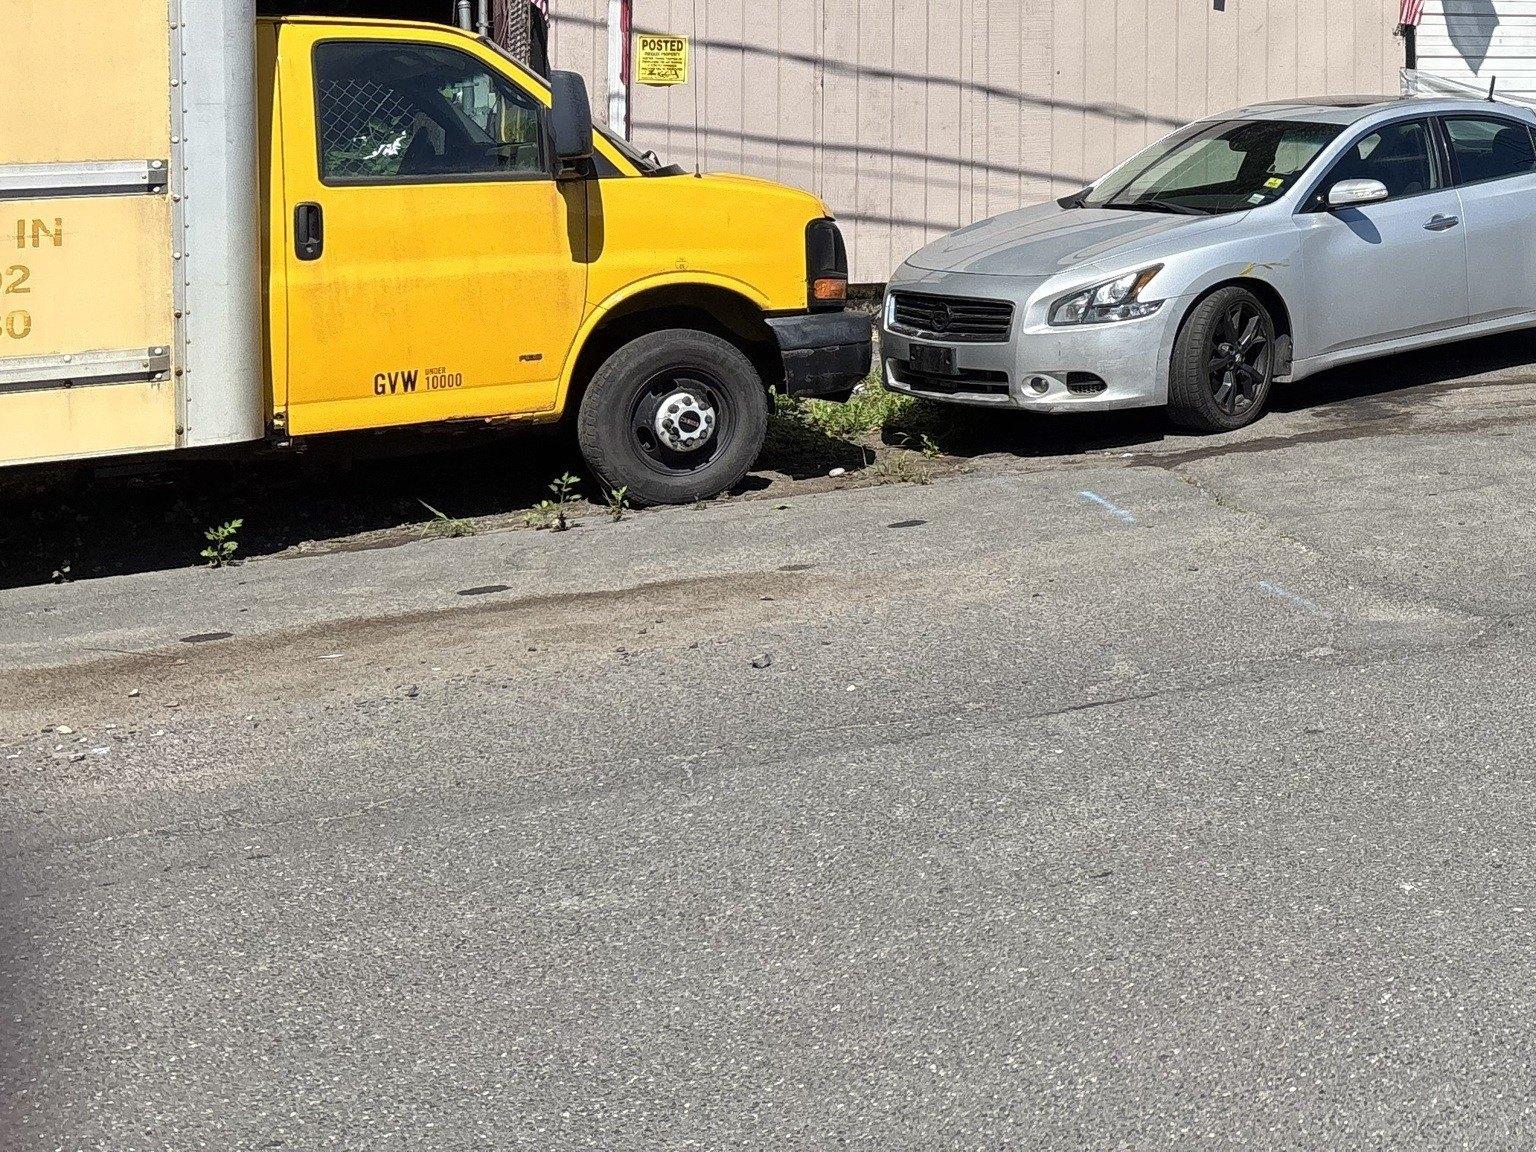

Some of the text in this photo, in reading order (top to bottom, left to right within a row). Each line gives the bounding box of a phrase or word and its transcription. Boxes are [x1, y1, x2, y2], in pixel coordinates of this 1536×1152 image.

[641, 39, 684, 51] POSTED
[17, 218, 62, 248] IN
[374, 369, 462, 396] GVW 10000
